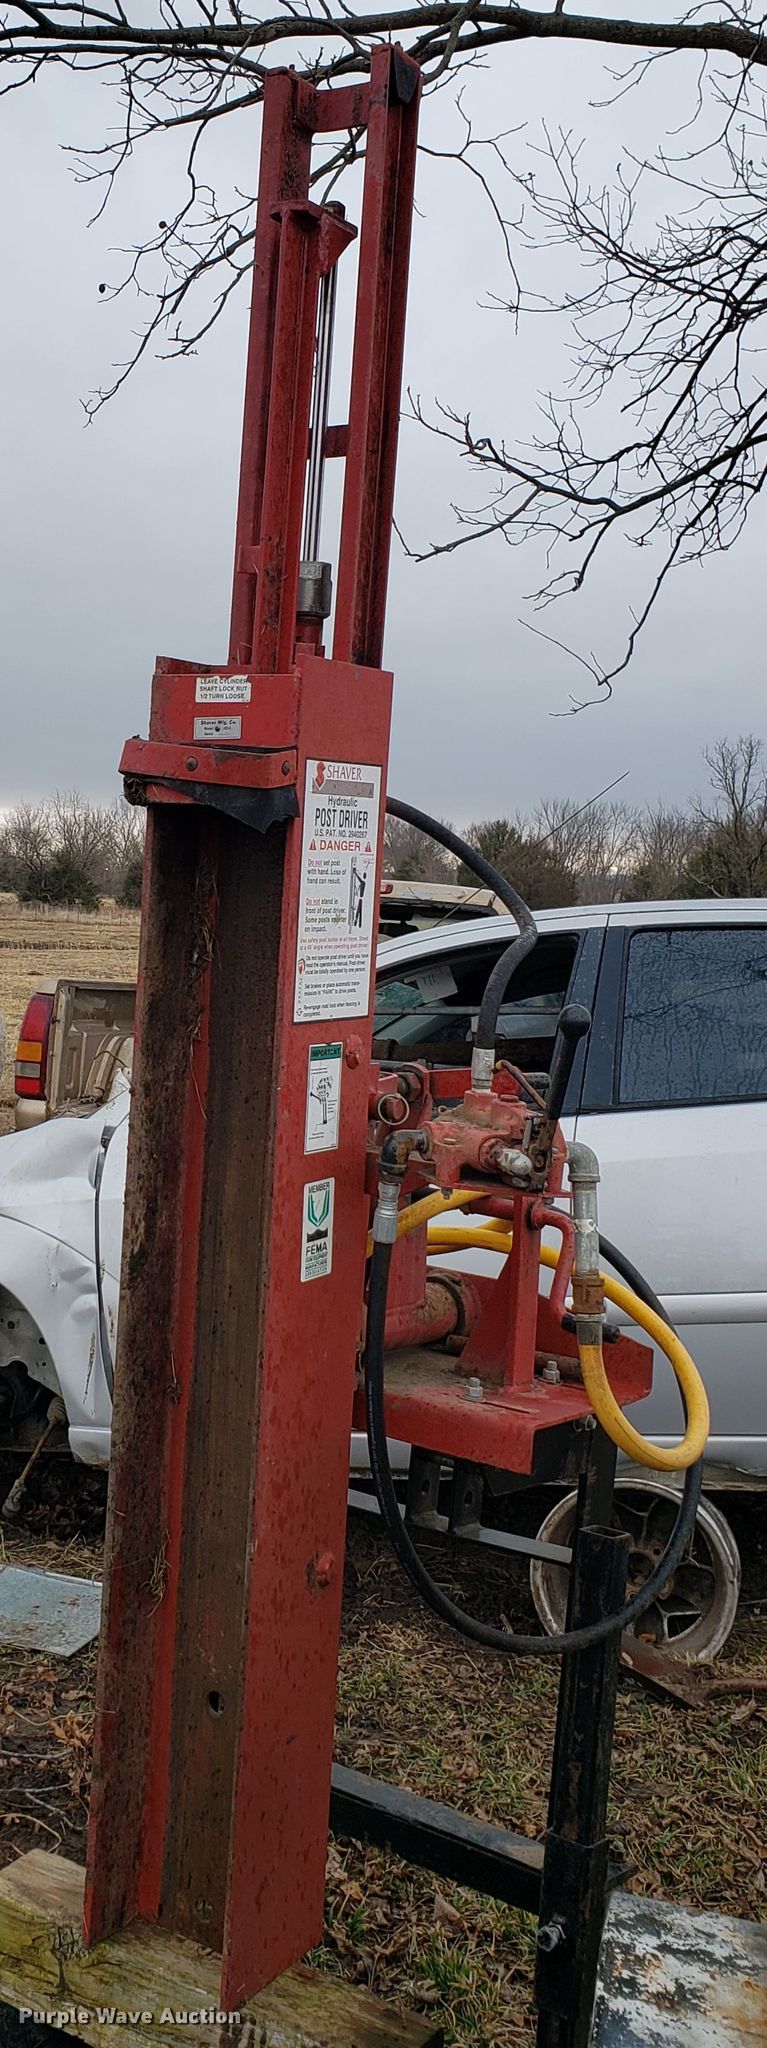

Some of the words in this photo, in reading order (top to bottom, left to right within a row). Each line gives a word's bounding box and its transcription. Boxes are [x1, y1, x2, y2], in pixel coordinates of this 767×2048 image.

[327, 765, 362, 780] SHAVER
[328, 796, 358, 808] Hydraulic
[315, 808, 337, 827] POST
[339, 810, 368, 829] DRIVER
[315, 828, 324, 837] U.S.
[320, 840, 361, 851] DANGER
[308, 1182, 330, 1193] MEMBER
[306, 1241, 327, 1256] FEMA
